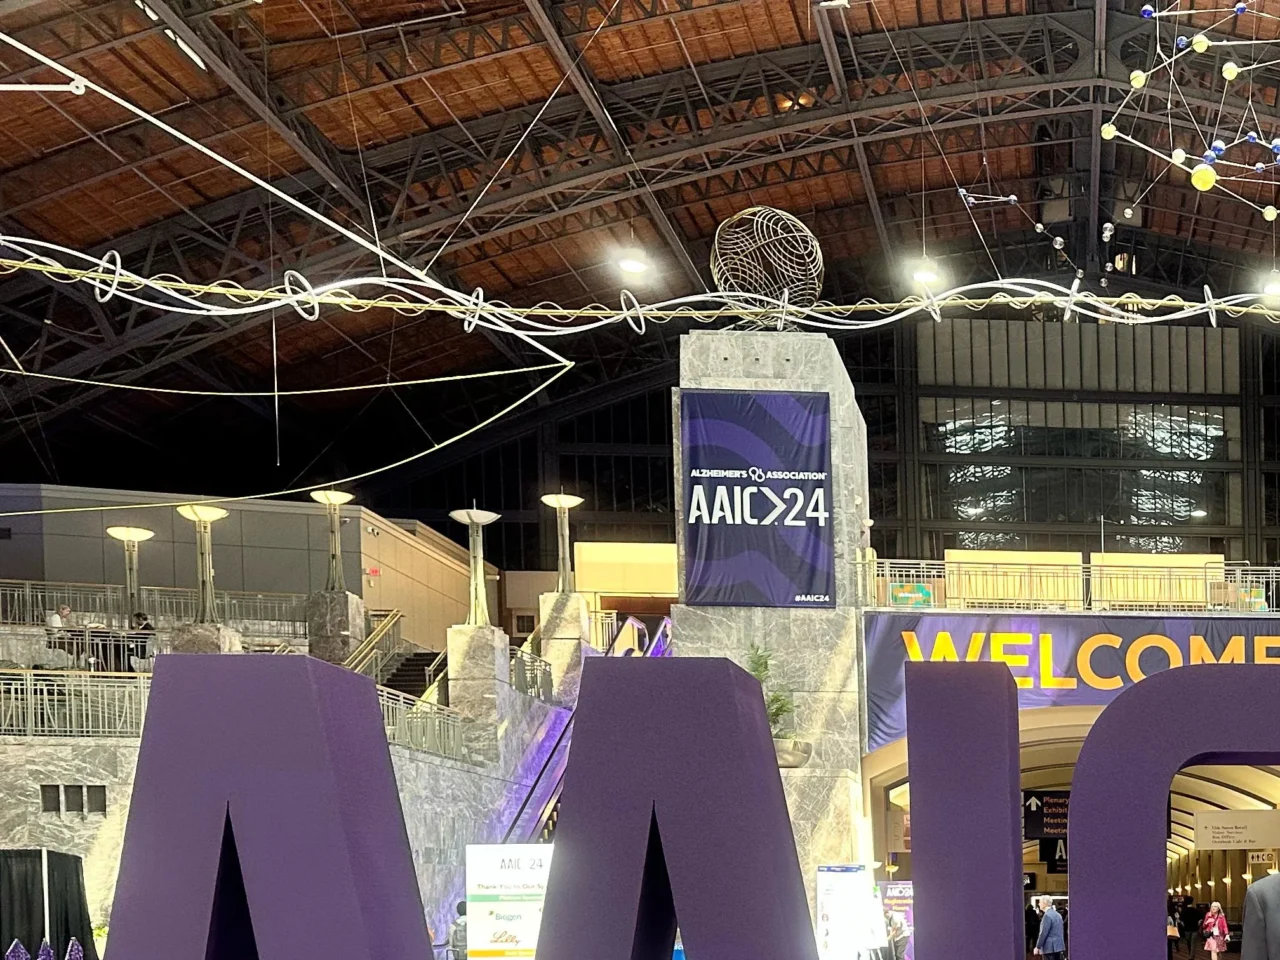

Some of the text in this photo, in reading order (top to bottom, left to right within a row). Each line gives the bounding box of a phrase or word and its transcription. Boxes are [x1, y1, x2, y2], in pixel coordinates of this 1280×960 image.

[690, 468, 748, 478] ALZHEIMER'S
[794, 594, 830, 602] #AAIC24
[495, 913, 522, 921] Biogen
[490, 930, 521, 946] Lilly
